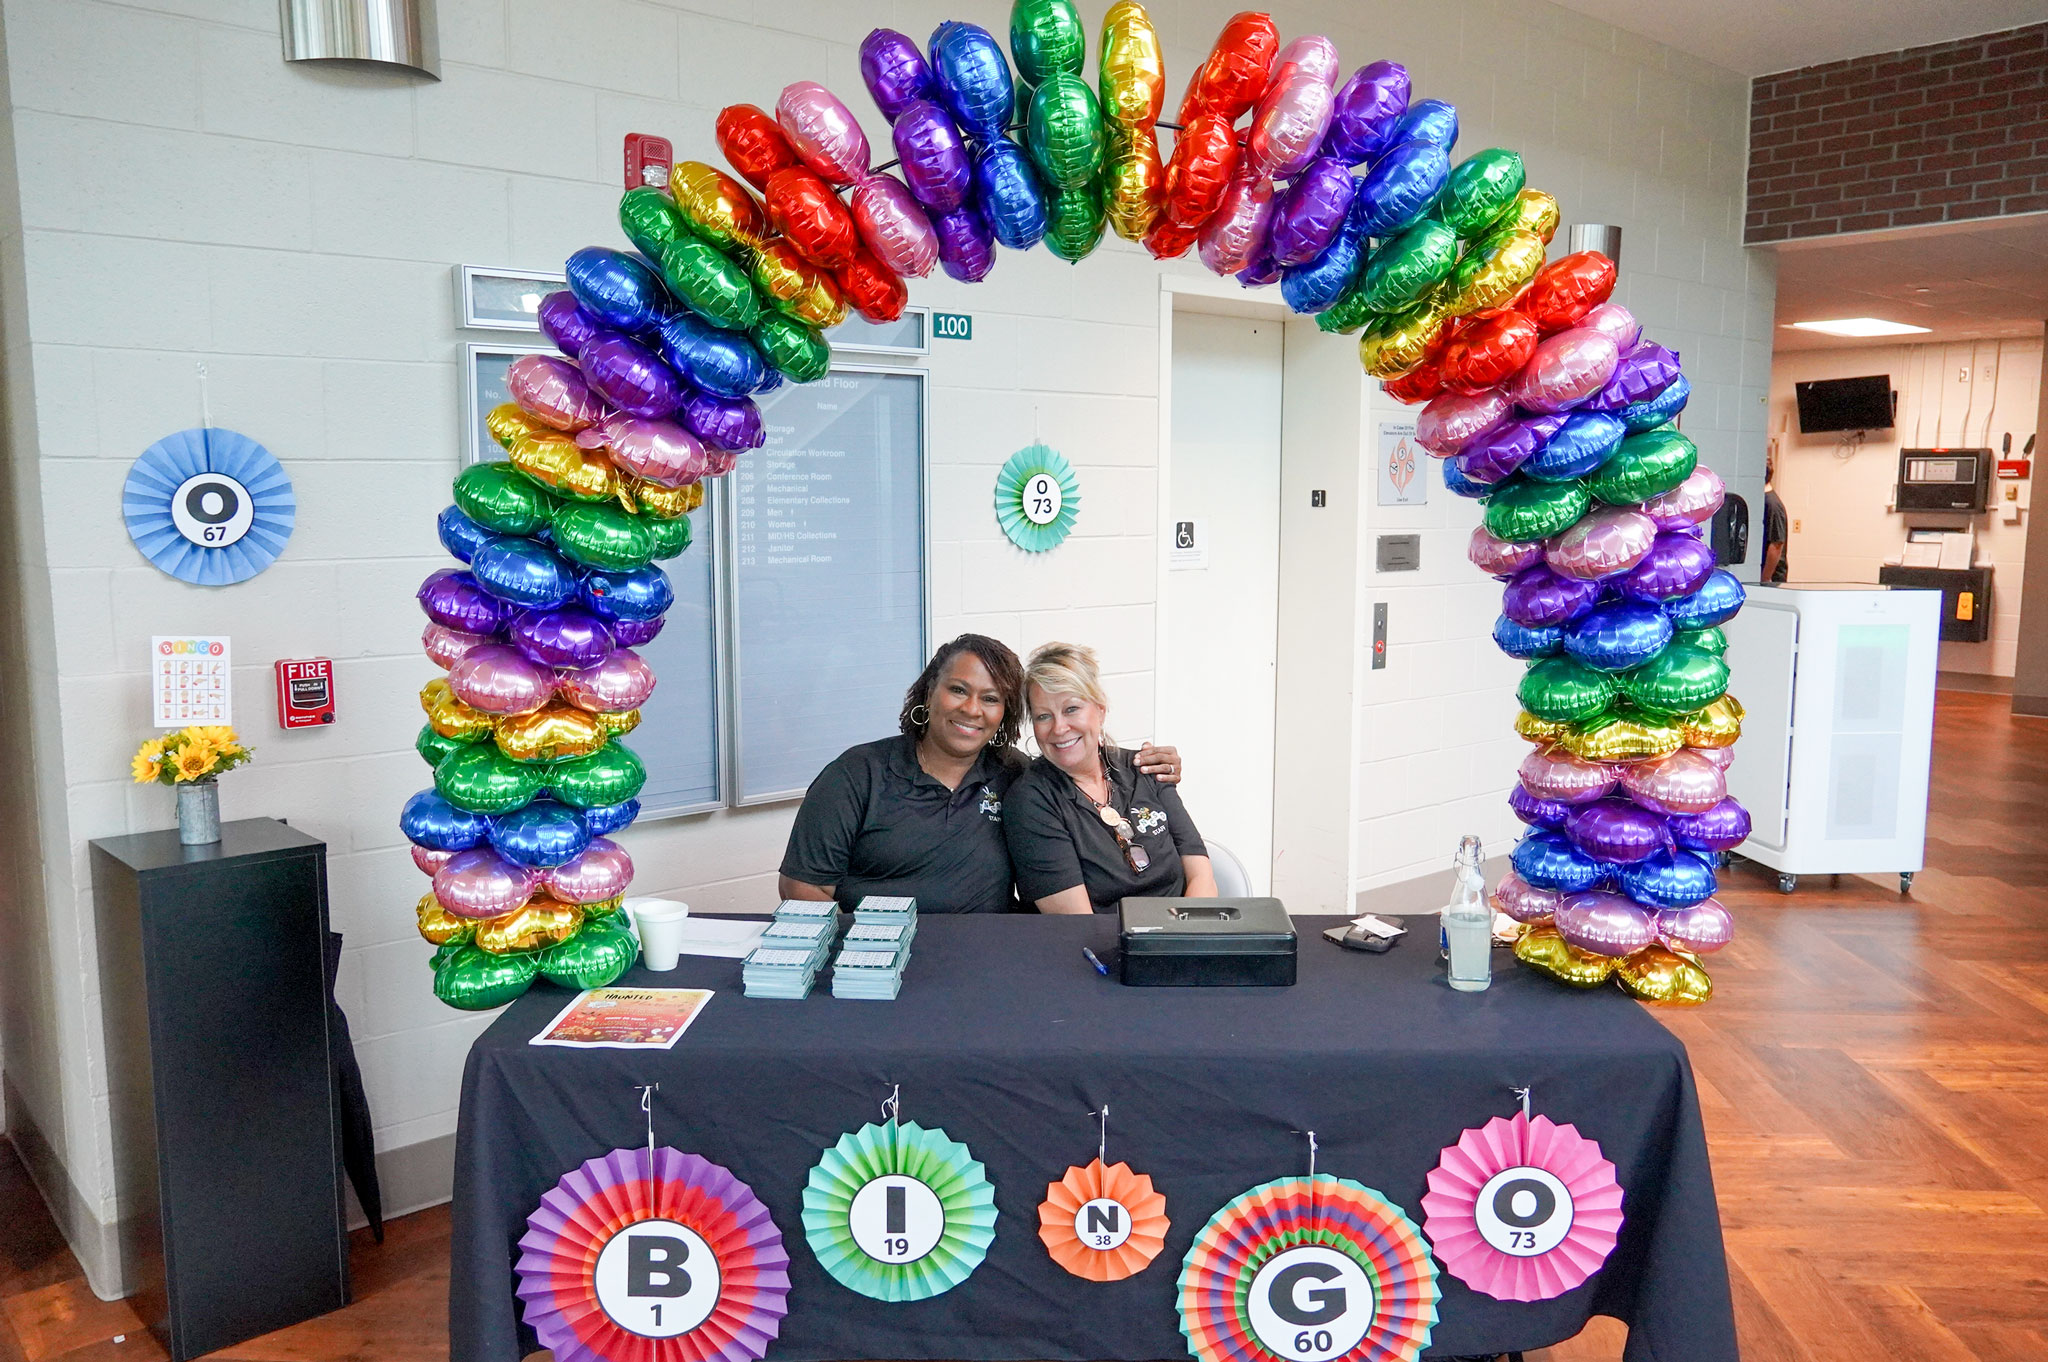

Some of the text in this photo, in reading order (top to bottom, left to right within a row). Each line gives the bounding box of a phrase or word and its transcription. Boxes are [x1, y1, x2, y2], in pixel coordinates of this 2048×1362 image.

[938, 315, 968, 337] 100
[834, 378, 860, 389] Floor
[485, 390, 501, 399] No.
[817, 402, 838, 411] Name
[766, 425, 795, 434] Storage
[766, 437, 784, 445] Staff
[766, 449, 845, 457] Circulation Workroom
[766, 460, 796, 470] Storage
[767, 472, 809, 481] Conference
[741, 485, 809, 493] 207 Mechanical
[185, 482, 239, 524] O
[741, 496, 850, 505] 208 Elementary Collections
[1033, 499, 1053, 514] 73
[741, 509, 783, 517] 209 Men
[741, 520, 796, 528] 210 Women
[203, 527, 227, 542] 67
[741, 533, 755, 541] 211
[797, 531, 837, 540] Collections
[742, 544, 794, 553] 212 Janitor
[742, 554, 832, 565] 213 Mechanical Room
[161, 642, 222, 655] BINGO
[287, 662, 328, 678] FIRE
[1152, 825, 1167, 836] STAFF
[1491, 1178, 1556, 1228] O
[886, 1186, 906, 1233] I
[1087, 1206, 1119, 1233] N
[1094, 1234, 1111, 1246] 38
[1510, 1231, 1537, 1249] 73
[884, 1238, 909, 1256] 19
[627, 1235, 692, 1298] B
[1268, 1262, 1347, 1326] G
[650, 1304, 662, 1326] 1
[1294, 1330, 1333, 1352] 60
